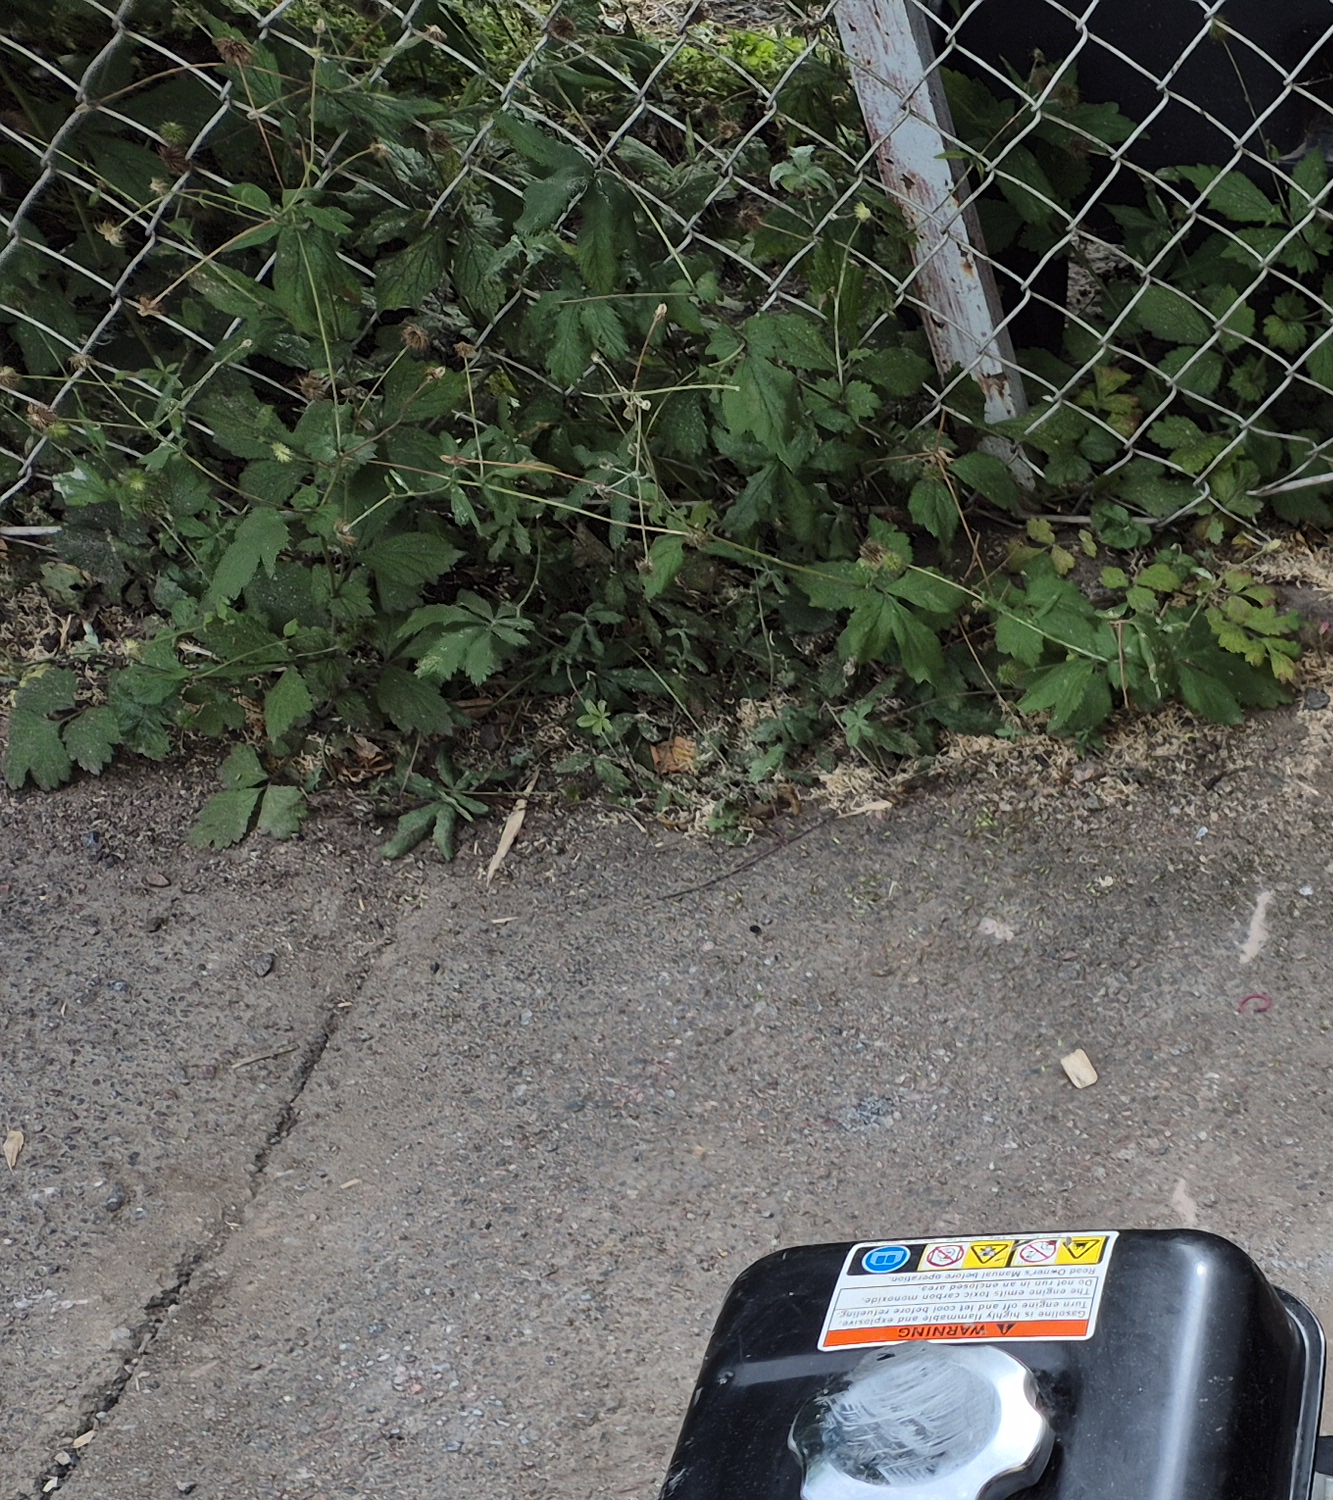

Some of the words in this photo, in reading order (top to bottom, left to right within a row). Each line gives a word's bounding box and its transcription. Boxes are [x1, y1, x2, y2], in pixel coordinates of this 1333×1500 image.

[981, 1270, 1021, 1278] Manual
[1024, 1268, 1066, 1276] Owner's
[1069, 1267, 1096, 1275] Read
[945, 1271, 978, 1280] before
[949, 1281, 999, 1290] enclosed
[1078, 1279, 1093, 1287] Do
[963, 1290, 990, 1298] toxic
[994, 1289, 1025, 1297] emits
[1028, 1287, 1067, 1296] engine
[1070, 1287, 1091, 1295] The
[922, 1292, 960, 1300] carbon
[933, 1304, 956, 1313] cool
[960, 1304, 974, 1312] let
[978, 1302, 998, 1311] and
[1002, 1302, 1018, 1310] off
[1022, 1301, 1059, 1309] engine
[1063, 1301, 1087, 1309] Turn
[893, 1305, 930, 1315] before
[1038, 1310, 1086, 1318] Gasoline
[925, 1312, 982, 1321] flammable
[986, 1310, 1020, 1319] highly
[898, 1315, 919, 1323] and
[898, 1323, 986, 1338] WARNING
